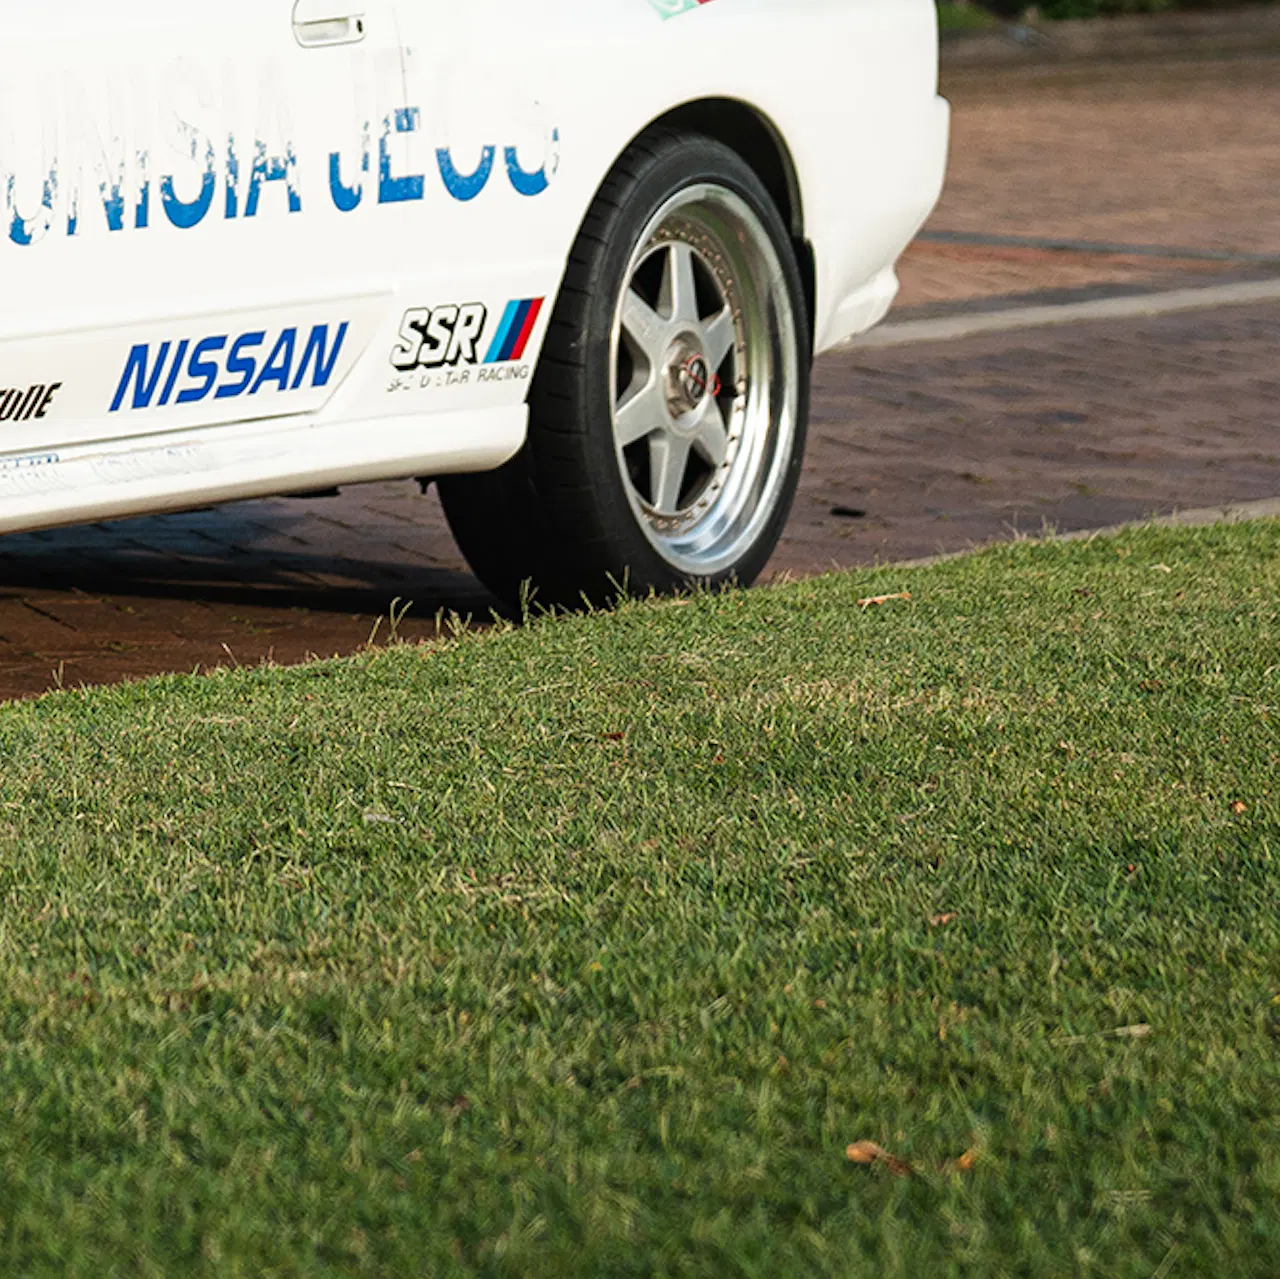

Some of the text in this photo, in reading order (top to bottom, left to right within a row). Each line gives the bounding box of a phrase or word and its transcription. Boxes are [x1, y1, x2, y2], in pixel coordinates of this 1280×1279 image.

[109, 320, 350, 412] NISSAN
[388, 302, 488, 371] SSR
[476, 365, 530, 383] RACING
